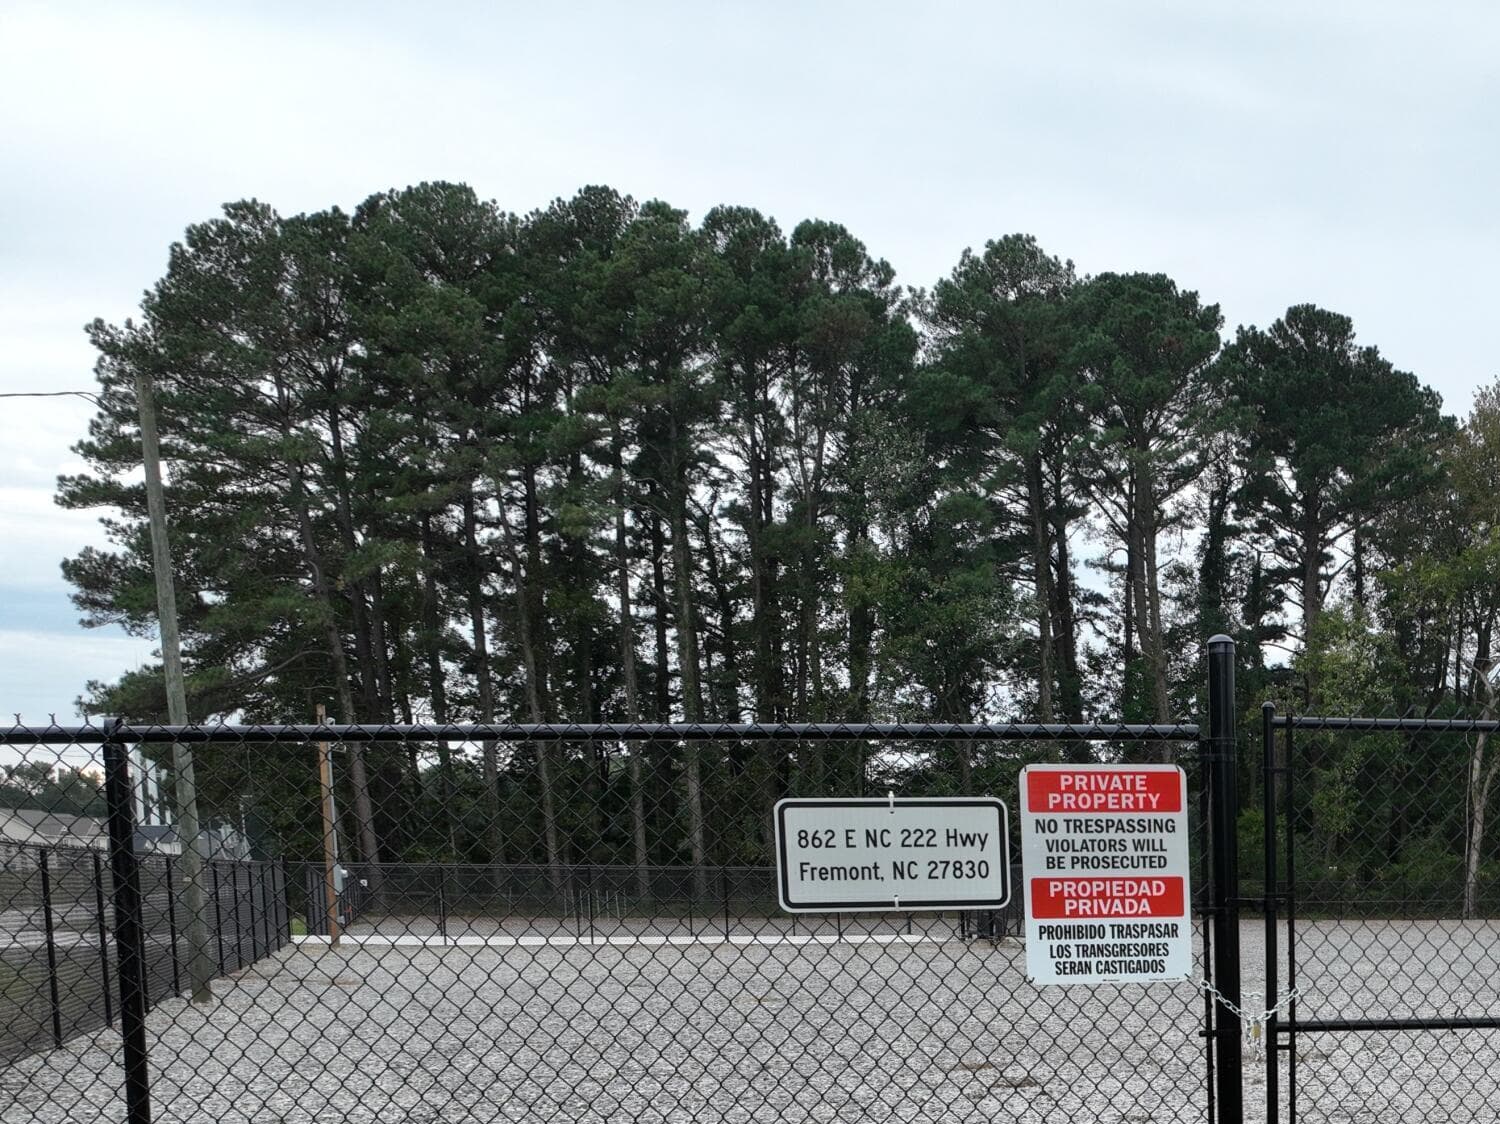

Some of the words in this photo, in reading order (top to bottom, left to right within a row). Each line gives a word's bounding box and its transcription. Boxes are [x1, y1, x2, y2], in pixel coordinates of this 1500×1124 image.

[1060, 775, 1147, 791] PRIVATE
[1048, 793, 1161, 809] PROPERTY
[1035, 819, 1058, 834] NO
[1063, 818, 1176, 833] TRESPASSING
[797, 829, 836, 848] 862
[845, 829, 857, 848] E
[866, 828, 891, 848] NC
[900, 828, 937, 847] 222
[946, 828, 988, 851] Hwy
[1045, 839, 1127, 853] VIOLATORS
[1132, 838, 1167, 852] WILL
[1046, 856, 1066, 869] BE
[1071, 856, 1167, 869] PROSECUTED
[800, 861, 884, 882] Fremont,
[892, 861, 918, 880] NC
[927, 860, 989, 879] 27830
[1049, 880, 1166, 897] PROPIEDAD
[1065, 898, 1151, 915] PRIVADA
[1038, 924, 1106, 940] PROHIBIDO
[1109, 923, 1179, 939] TRASPASAR
[1050, 944, 1072, 959] LOS
[1075, 943, 1169, 958] TRANSGRESORES
[1055, 961, 1092, 975] SERAN
[1096, 959, 1166, 975] CASTIGADOS
